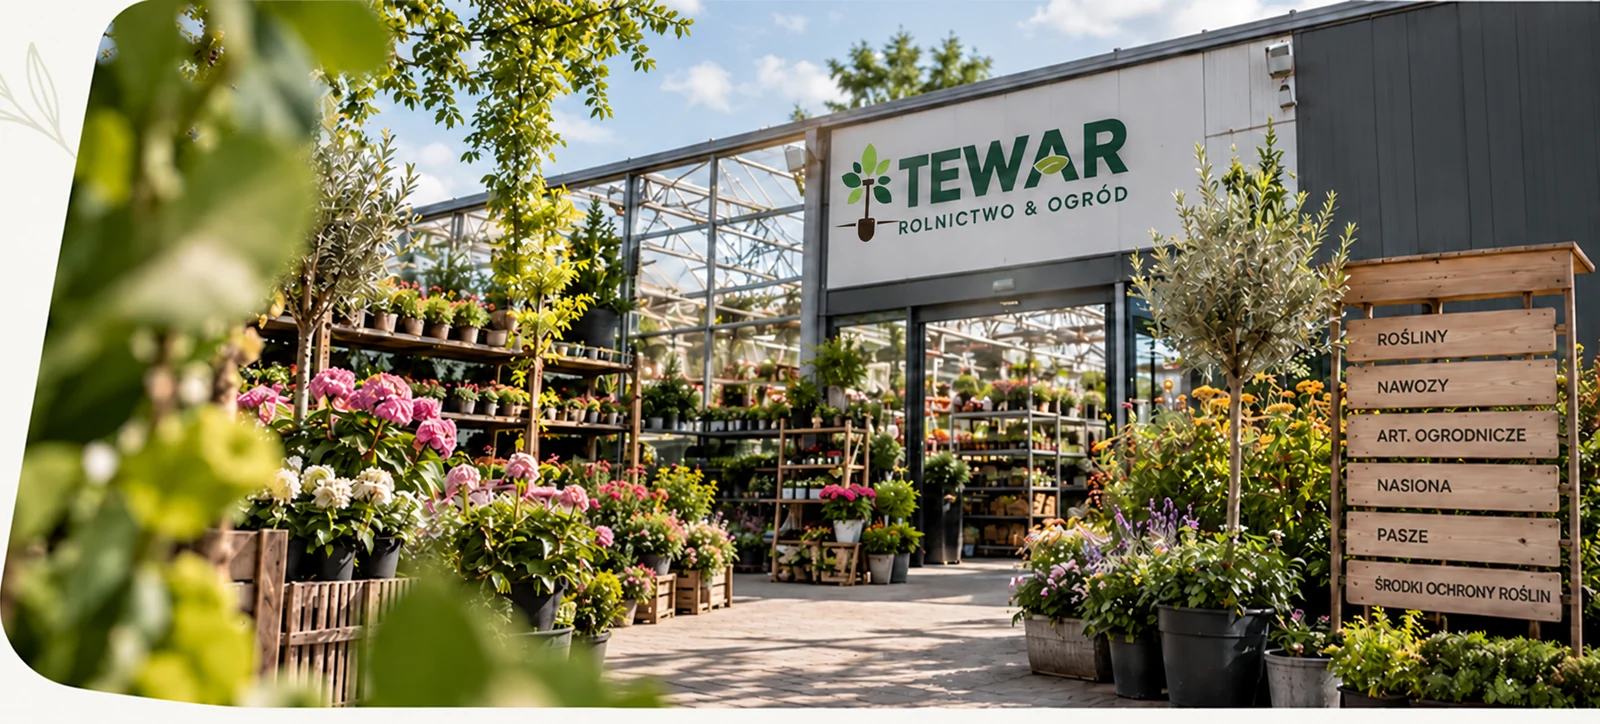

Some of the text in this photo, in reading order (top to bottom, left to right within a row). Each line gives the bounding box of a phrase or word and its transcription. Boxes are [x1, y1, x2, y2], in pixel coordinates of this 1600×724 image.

[898, 118, 1129, 208] TEWAR
[898, 184, 1128, 235] ROLNICTWO & OGRÓD
[1377, 328, 1448, 346] ROŚLINY
[1377, 378, 1449, 394] NAWOZY
[1377, 428, 1526, 442] ART. OGRODNICZE
[1377, 478, 1452, 493] NASIONA
[1377, 528, 1428, 543] PASZE
[1375, 576, 1551, 603] ŚRODKI OCHRONY ROŚLIN
